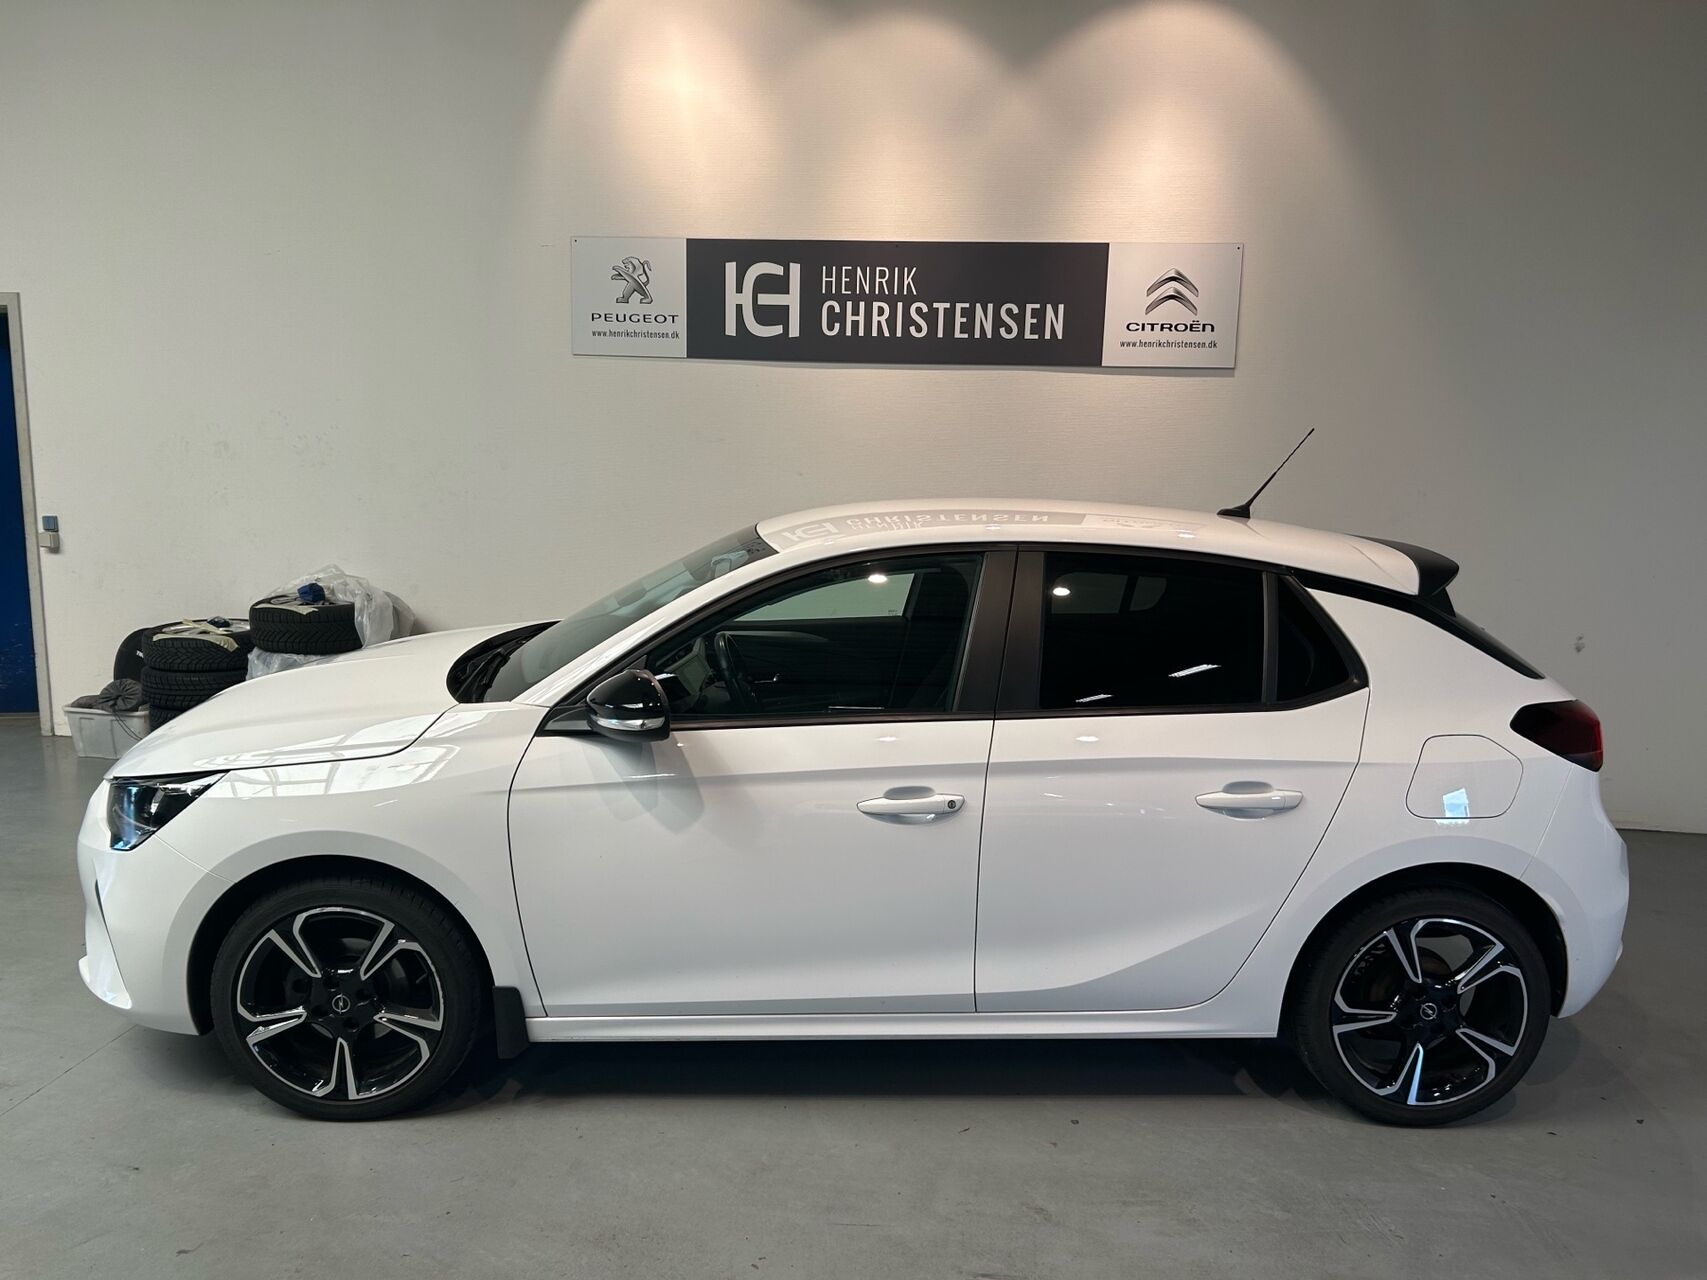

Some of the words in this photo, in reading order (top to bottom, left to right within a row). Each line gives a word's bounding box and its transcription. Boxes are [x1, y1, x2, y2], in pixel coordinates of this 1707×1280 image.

[822, 265, 918, 295] HENRIK
[591, 312, 679, 324] PEUGEOT
[822, 300, 1065, 340] CHRISTENSEN
[591, 329, 680, 339] www.henrikchristensen.dk
[1119, 339, 1218, 349] www.henrikchristensen.dk
